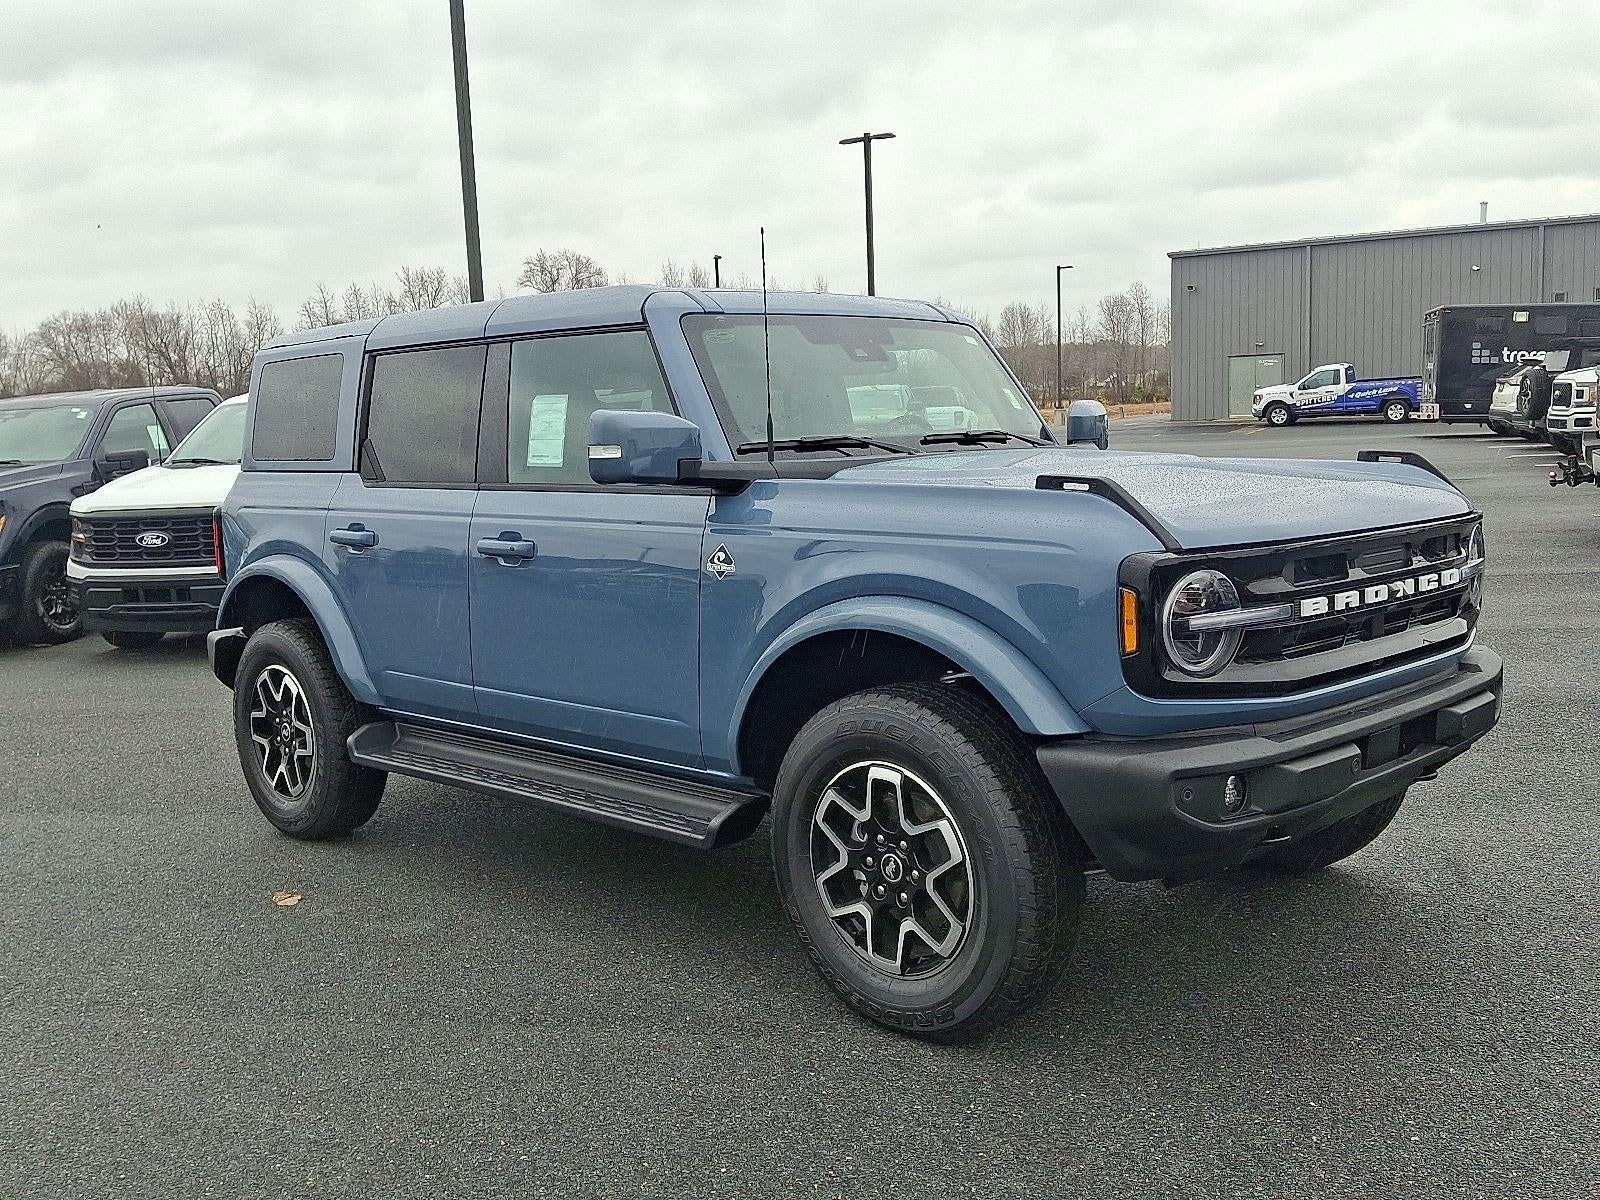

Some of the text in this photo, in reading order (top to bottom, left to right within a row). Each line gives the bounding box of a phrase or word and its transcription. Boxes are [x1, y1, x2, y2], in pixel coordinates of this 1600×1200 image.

[1355, 389, 1377, 398] Quick
[1300, 568, 1460, 618] BRONCO
[835, 719, 976, 802] DUELER
